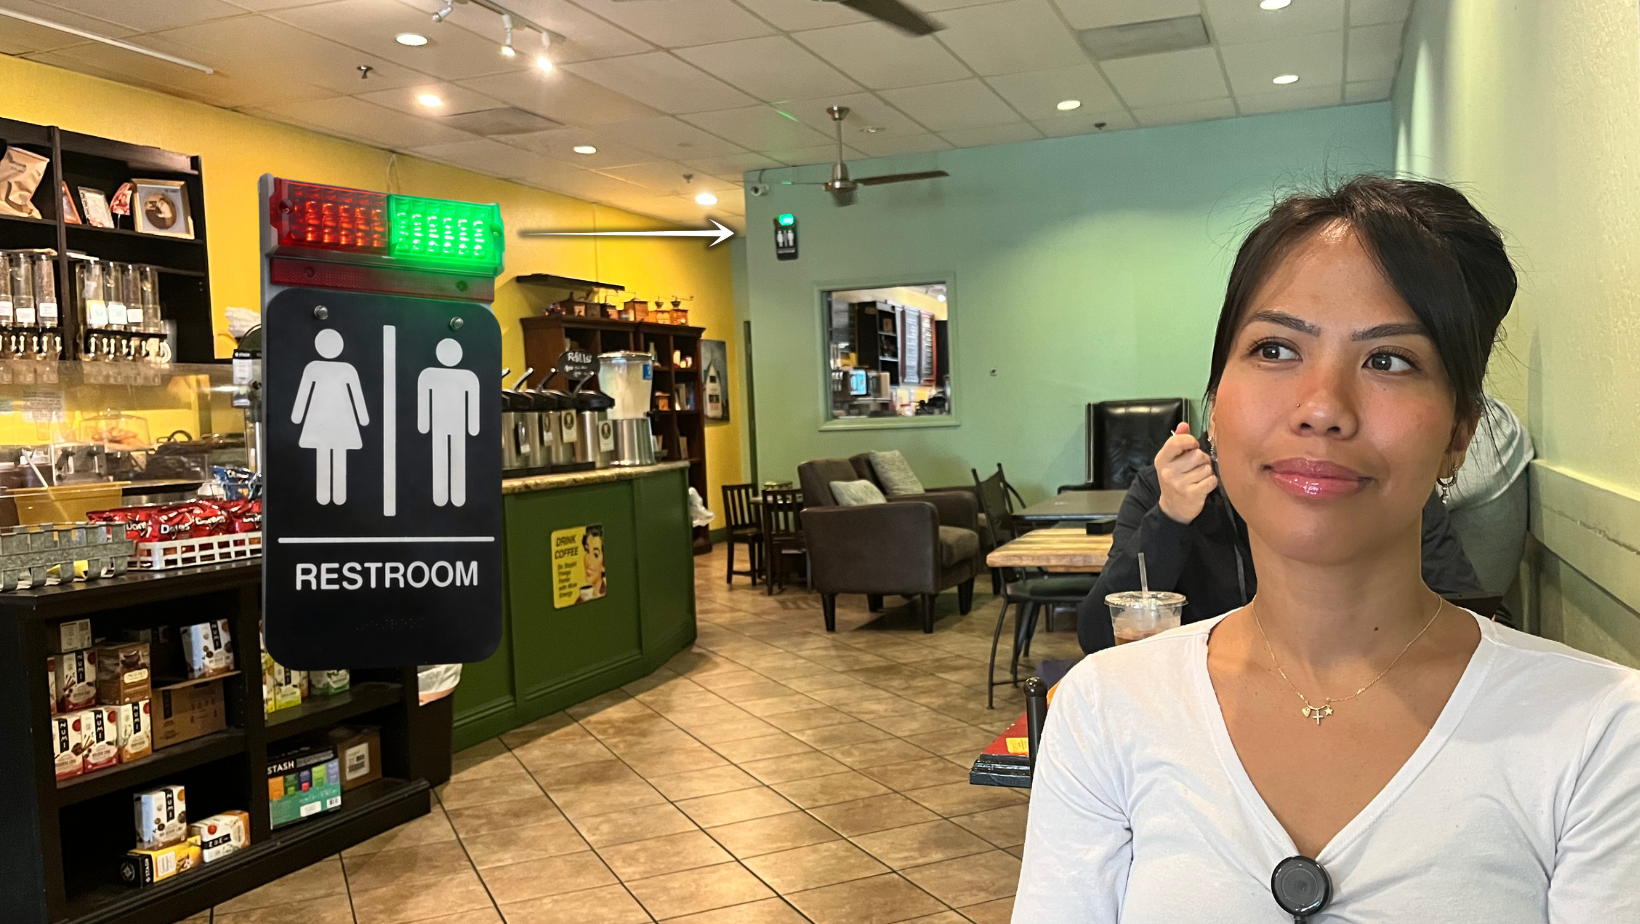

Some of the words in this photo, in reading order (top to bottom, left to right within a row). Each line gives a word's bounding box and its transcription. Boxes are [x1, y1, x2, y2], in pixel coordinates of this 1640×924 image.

[554, 547, 579, 560] COFFEE
[556, 534, 577, 547] DRINK
[296, 560, 478, 591] RESTROOM
[59, 721, 68, 749] NUMI
[95, 713, 104, 739] NUMI
[267, 760, 295, 775] STASH
[166, 793, 174, 819] NUMI
